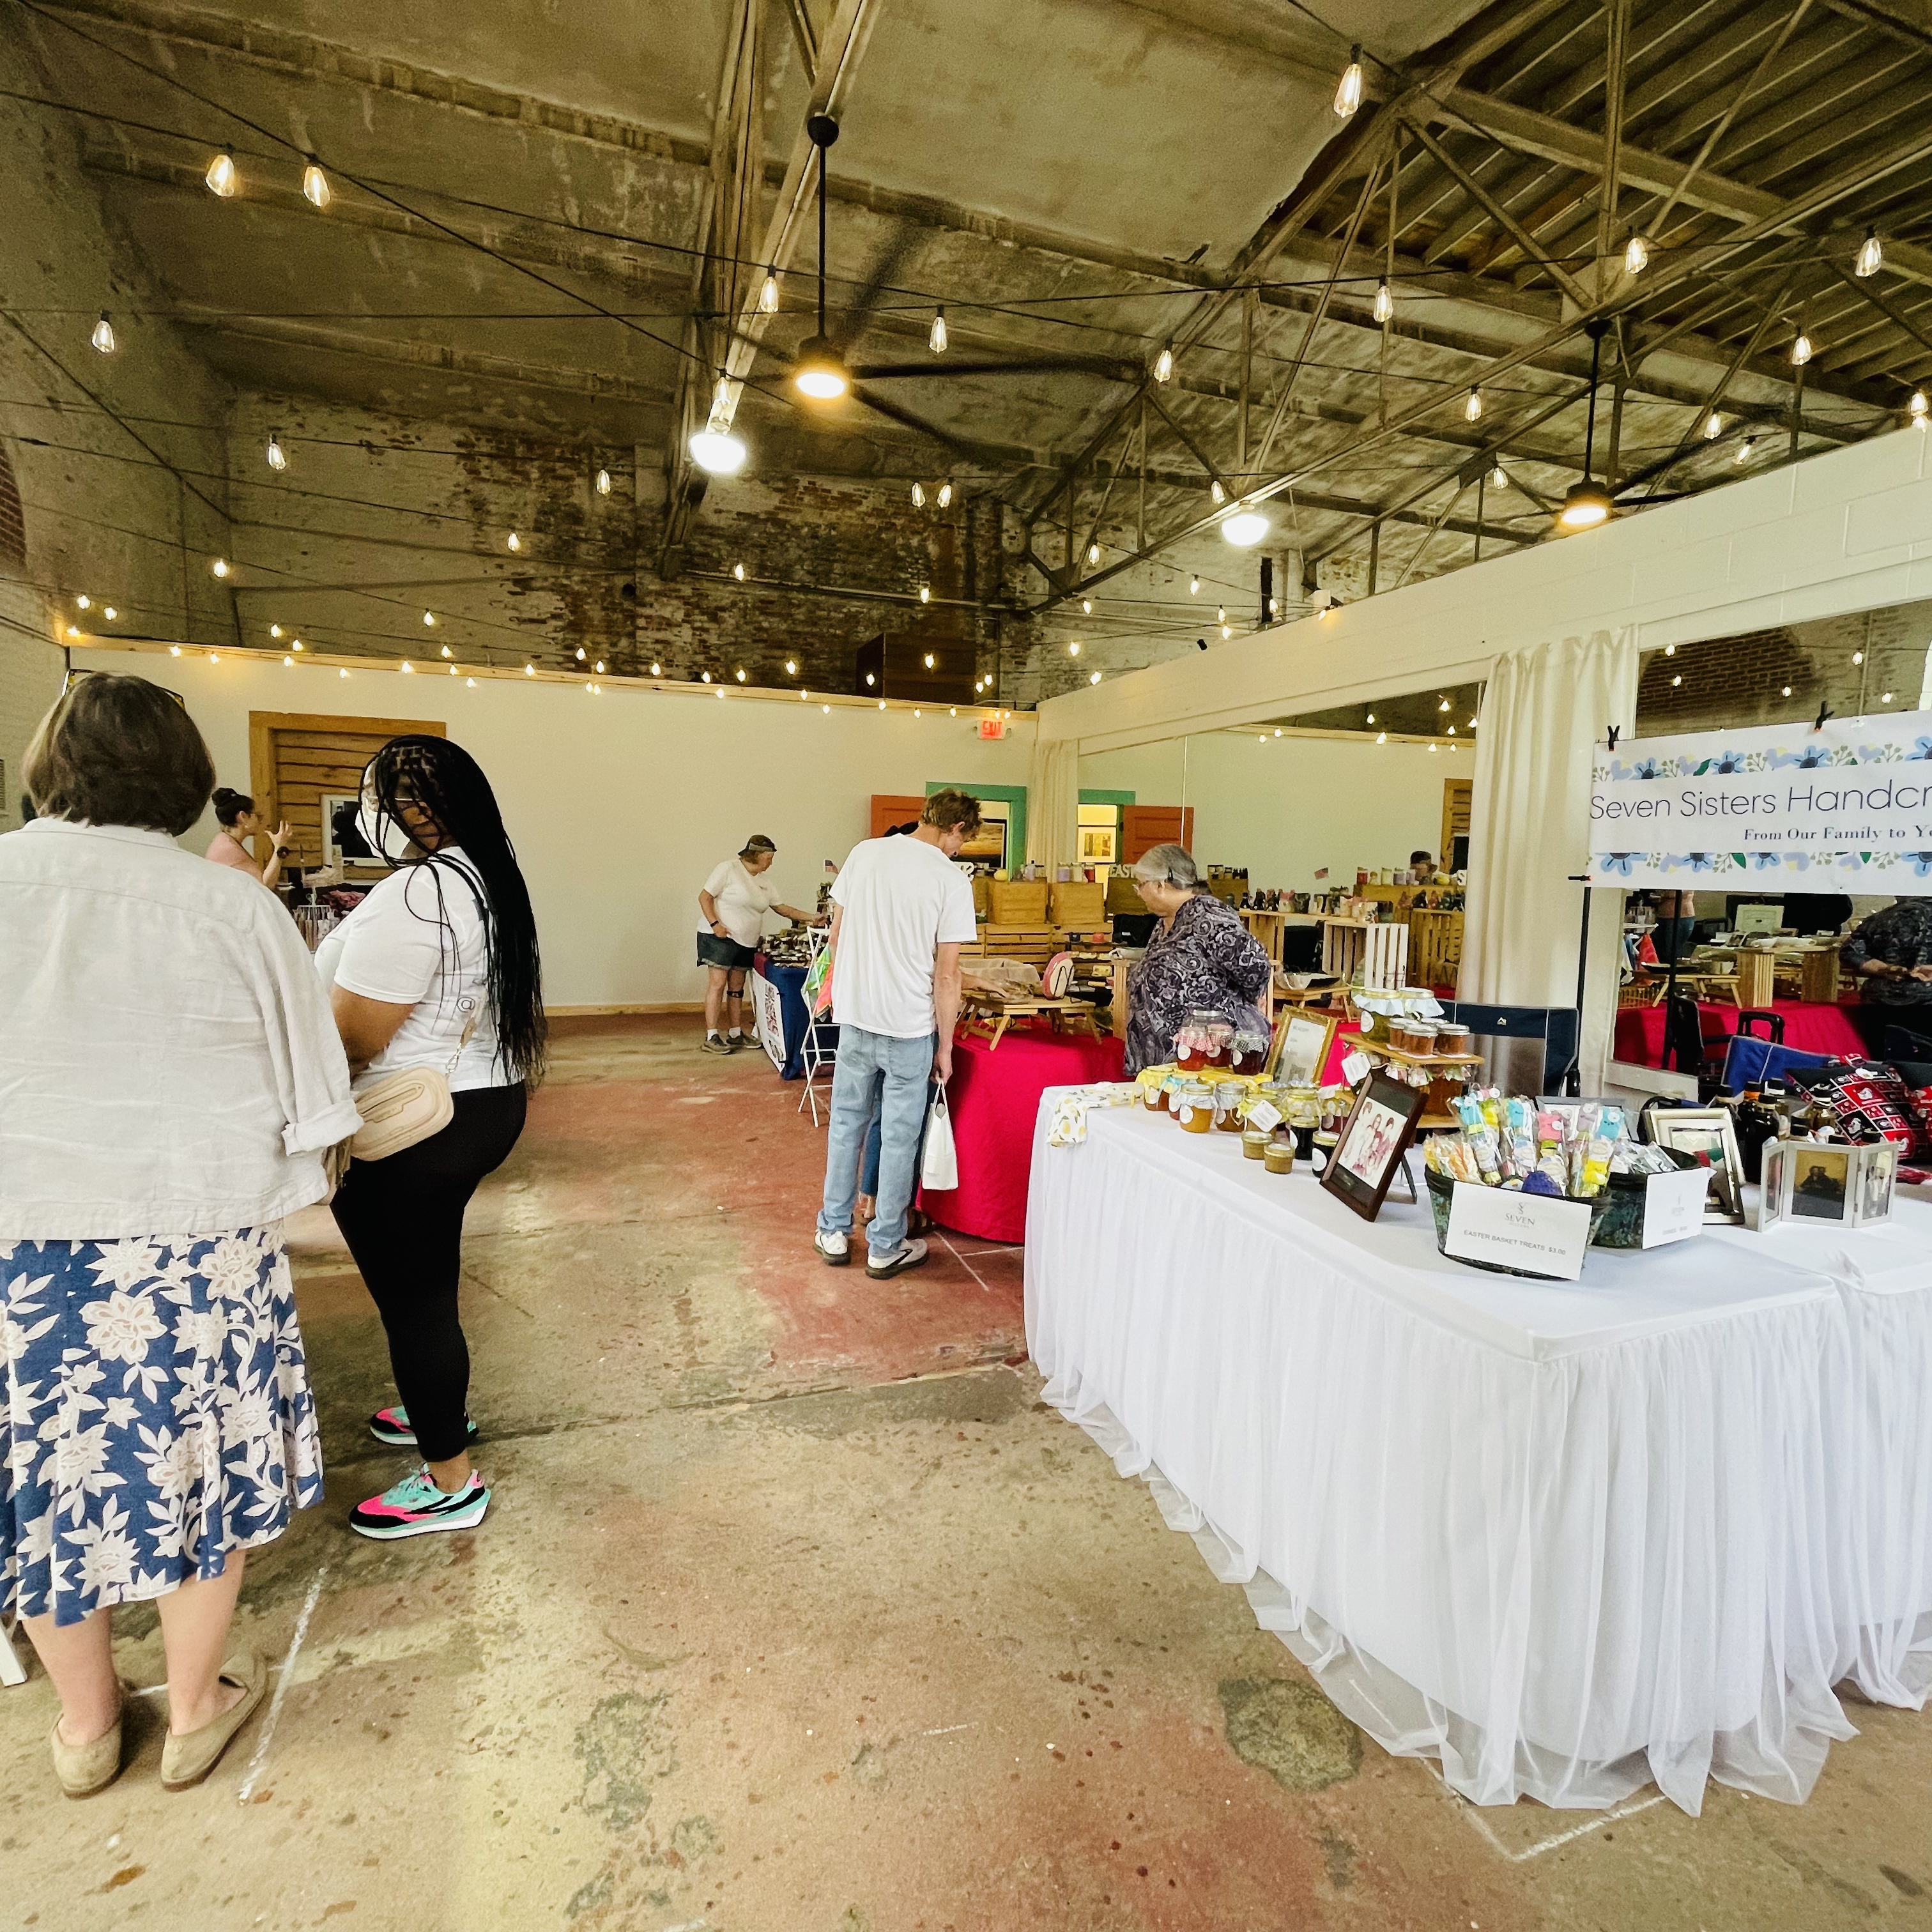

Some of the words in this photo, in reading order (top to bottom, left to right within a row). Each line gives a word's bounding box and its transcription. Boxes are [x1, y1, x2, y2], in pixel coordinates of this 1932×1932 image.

[983, 721, 1002, 736] EXIT
[1590, 795, 1671, 820] Seven
[1680, 790, 1777, 817] Sisters
[1744, 829, 1782, 841] From
[1788, 827, 1817, 840] Our
[1823, 826, 1882, 843] Family
[1889, 829, 1906, 839] to
[1914, 825, 1932, 838] Y
[1505, 1213, 1535, 1226] SEVEN
[1464, 1229, 1491, 1240] EASTER
[1492, 1235, 1517, 1245] BASKET
[1519, 1240, 1545, 1251] TREATS
[1548, 1246, 1566, 1255] $3.00
